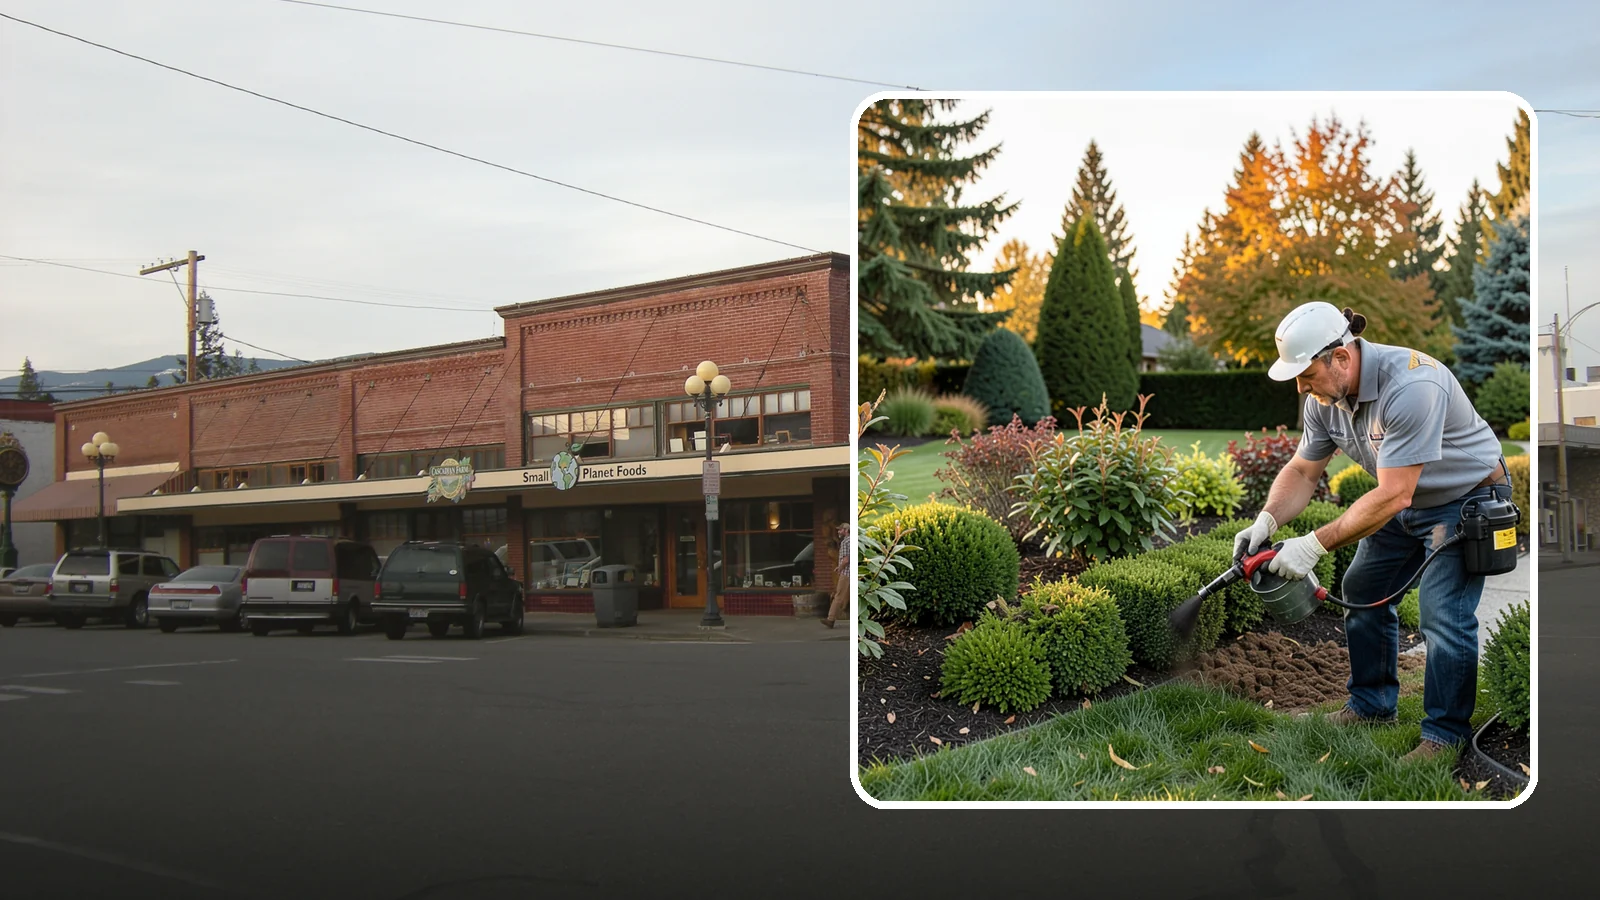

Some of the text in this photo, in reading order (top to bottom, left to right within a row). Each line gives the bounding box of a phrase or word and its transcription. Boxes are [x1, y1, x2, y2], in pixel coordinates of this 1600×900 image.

[523, 464, 647, 483] Small Planet Foods
